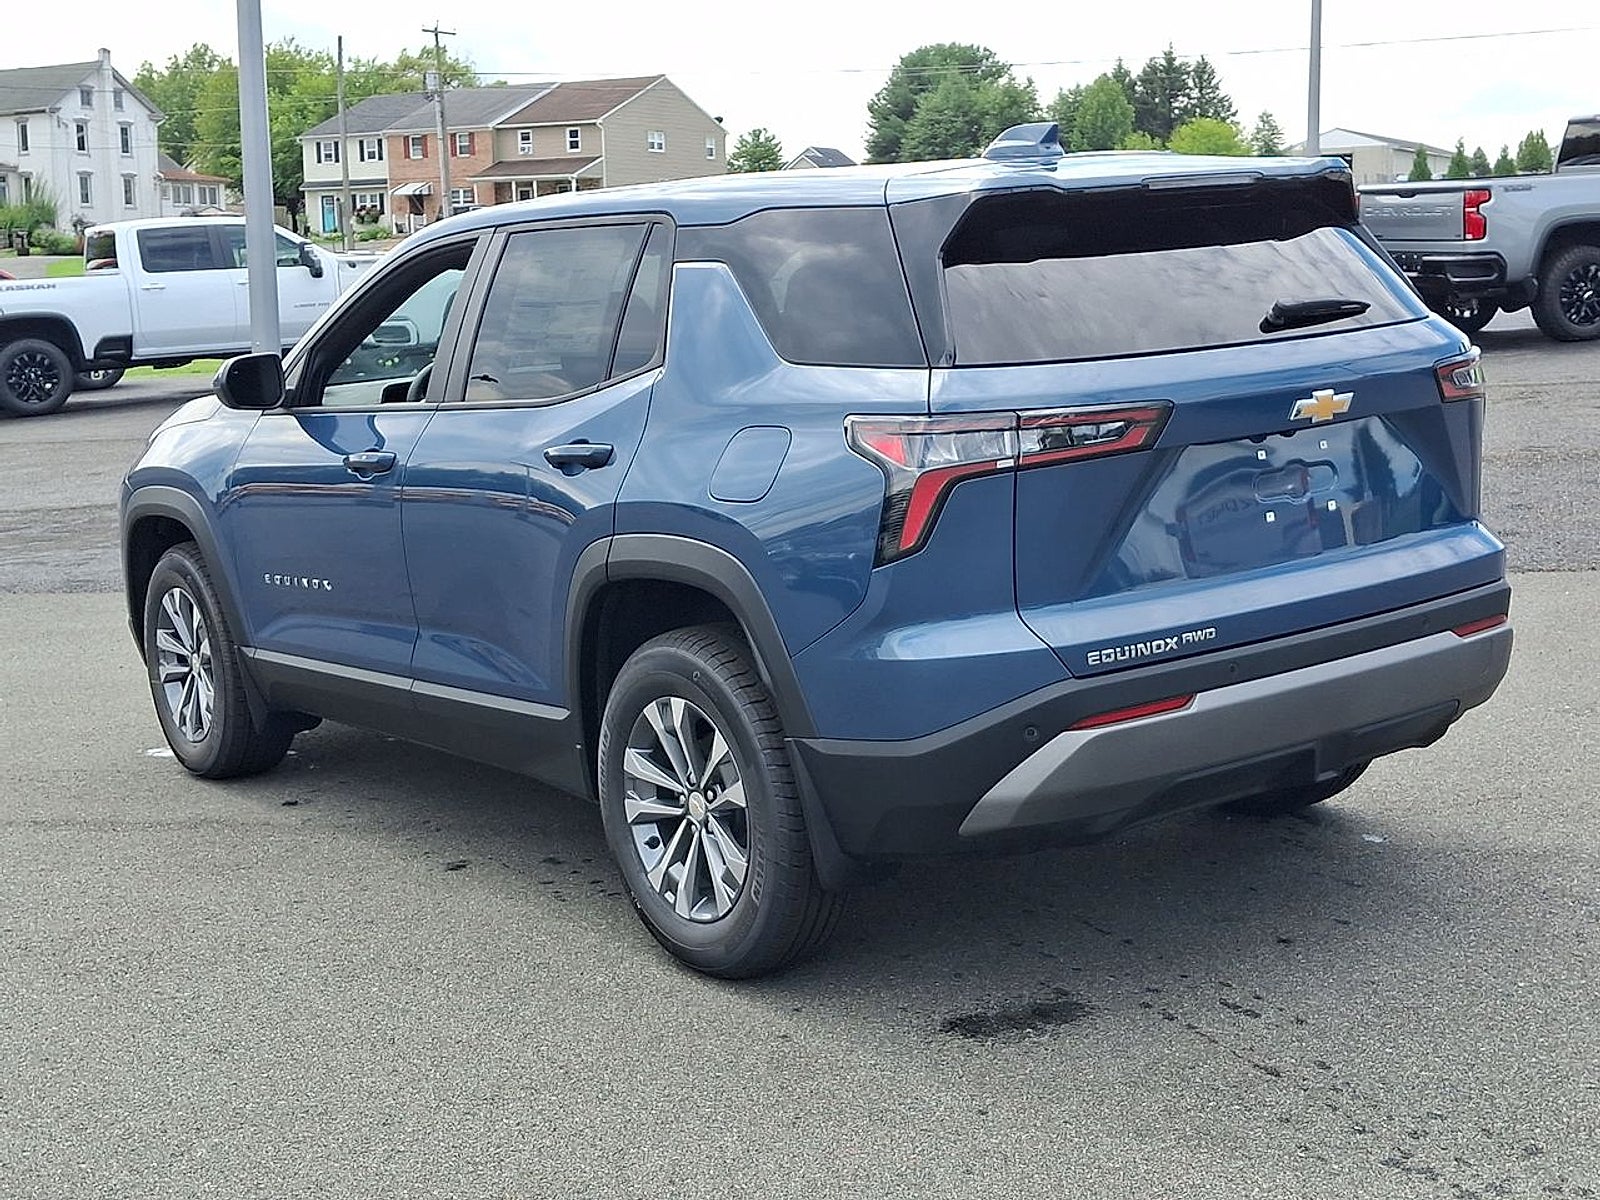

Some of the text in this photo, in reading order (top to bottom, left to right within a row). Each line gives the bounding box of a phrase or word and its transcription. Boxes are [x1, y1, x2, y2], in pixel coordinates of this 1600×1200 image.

[1364, 205, 1454, 218] CHEVROLET
[263, 573, 333, 591] EQUINOX
[1087, 627, 1217, 666] EQUINOX AWD
